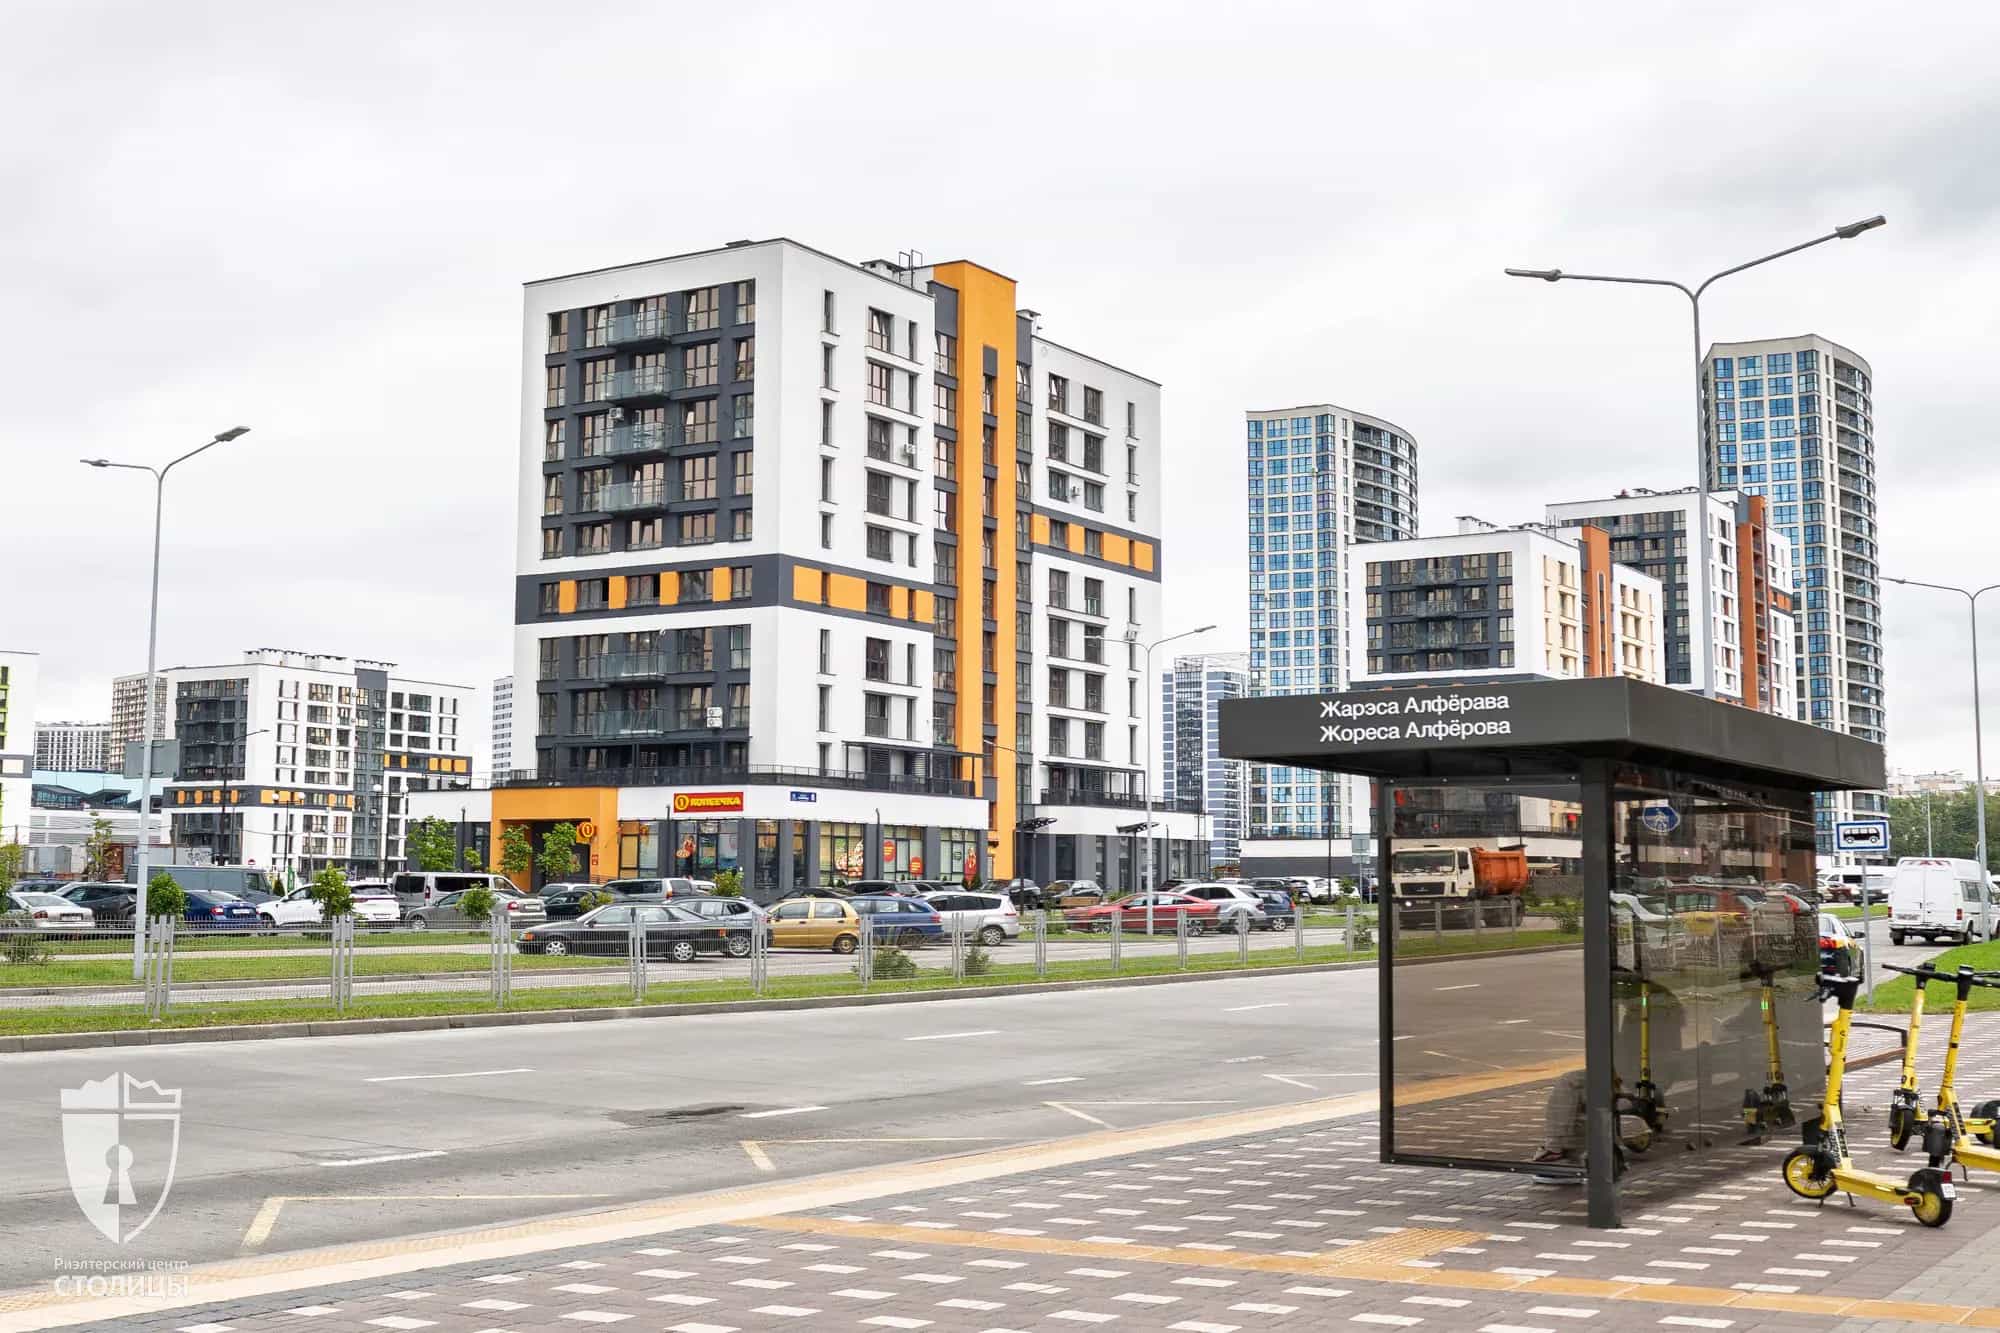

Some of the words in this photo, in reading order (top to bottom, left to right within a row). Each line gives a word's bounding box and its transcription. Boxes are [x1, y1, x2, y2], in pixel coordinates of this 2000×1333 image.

[1320, 700, 1400, 720] Жарэса
[1404, 693, 1510, 715] Алфёрава
[1320, 725, 1400, 745] Жореса
[1405, 719, 1511, 740] Алфёрова
